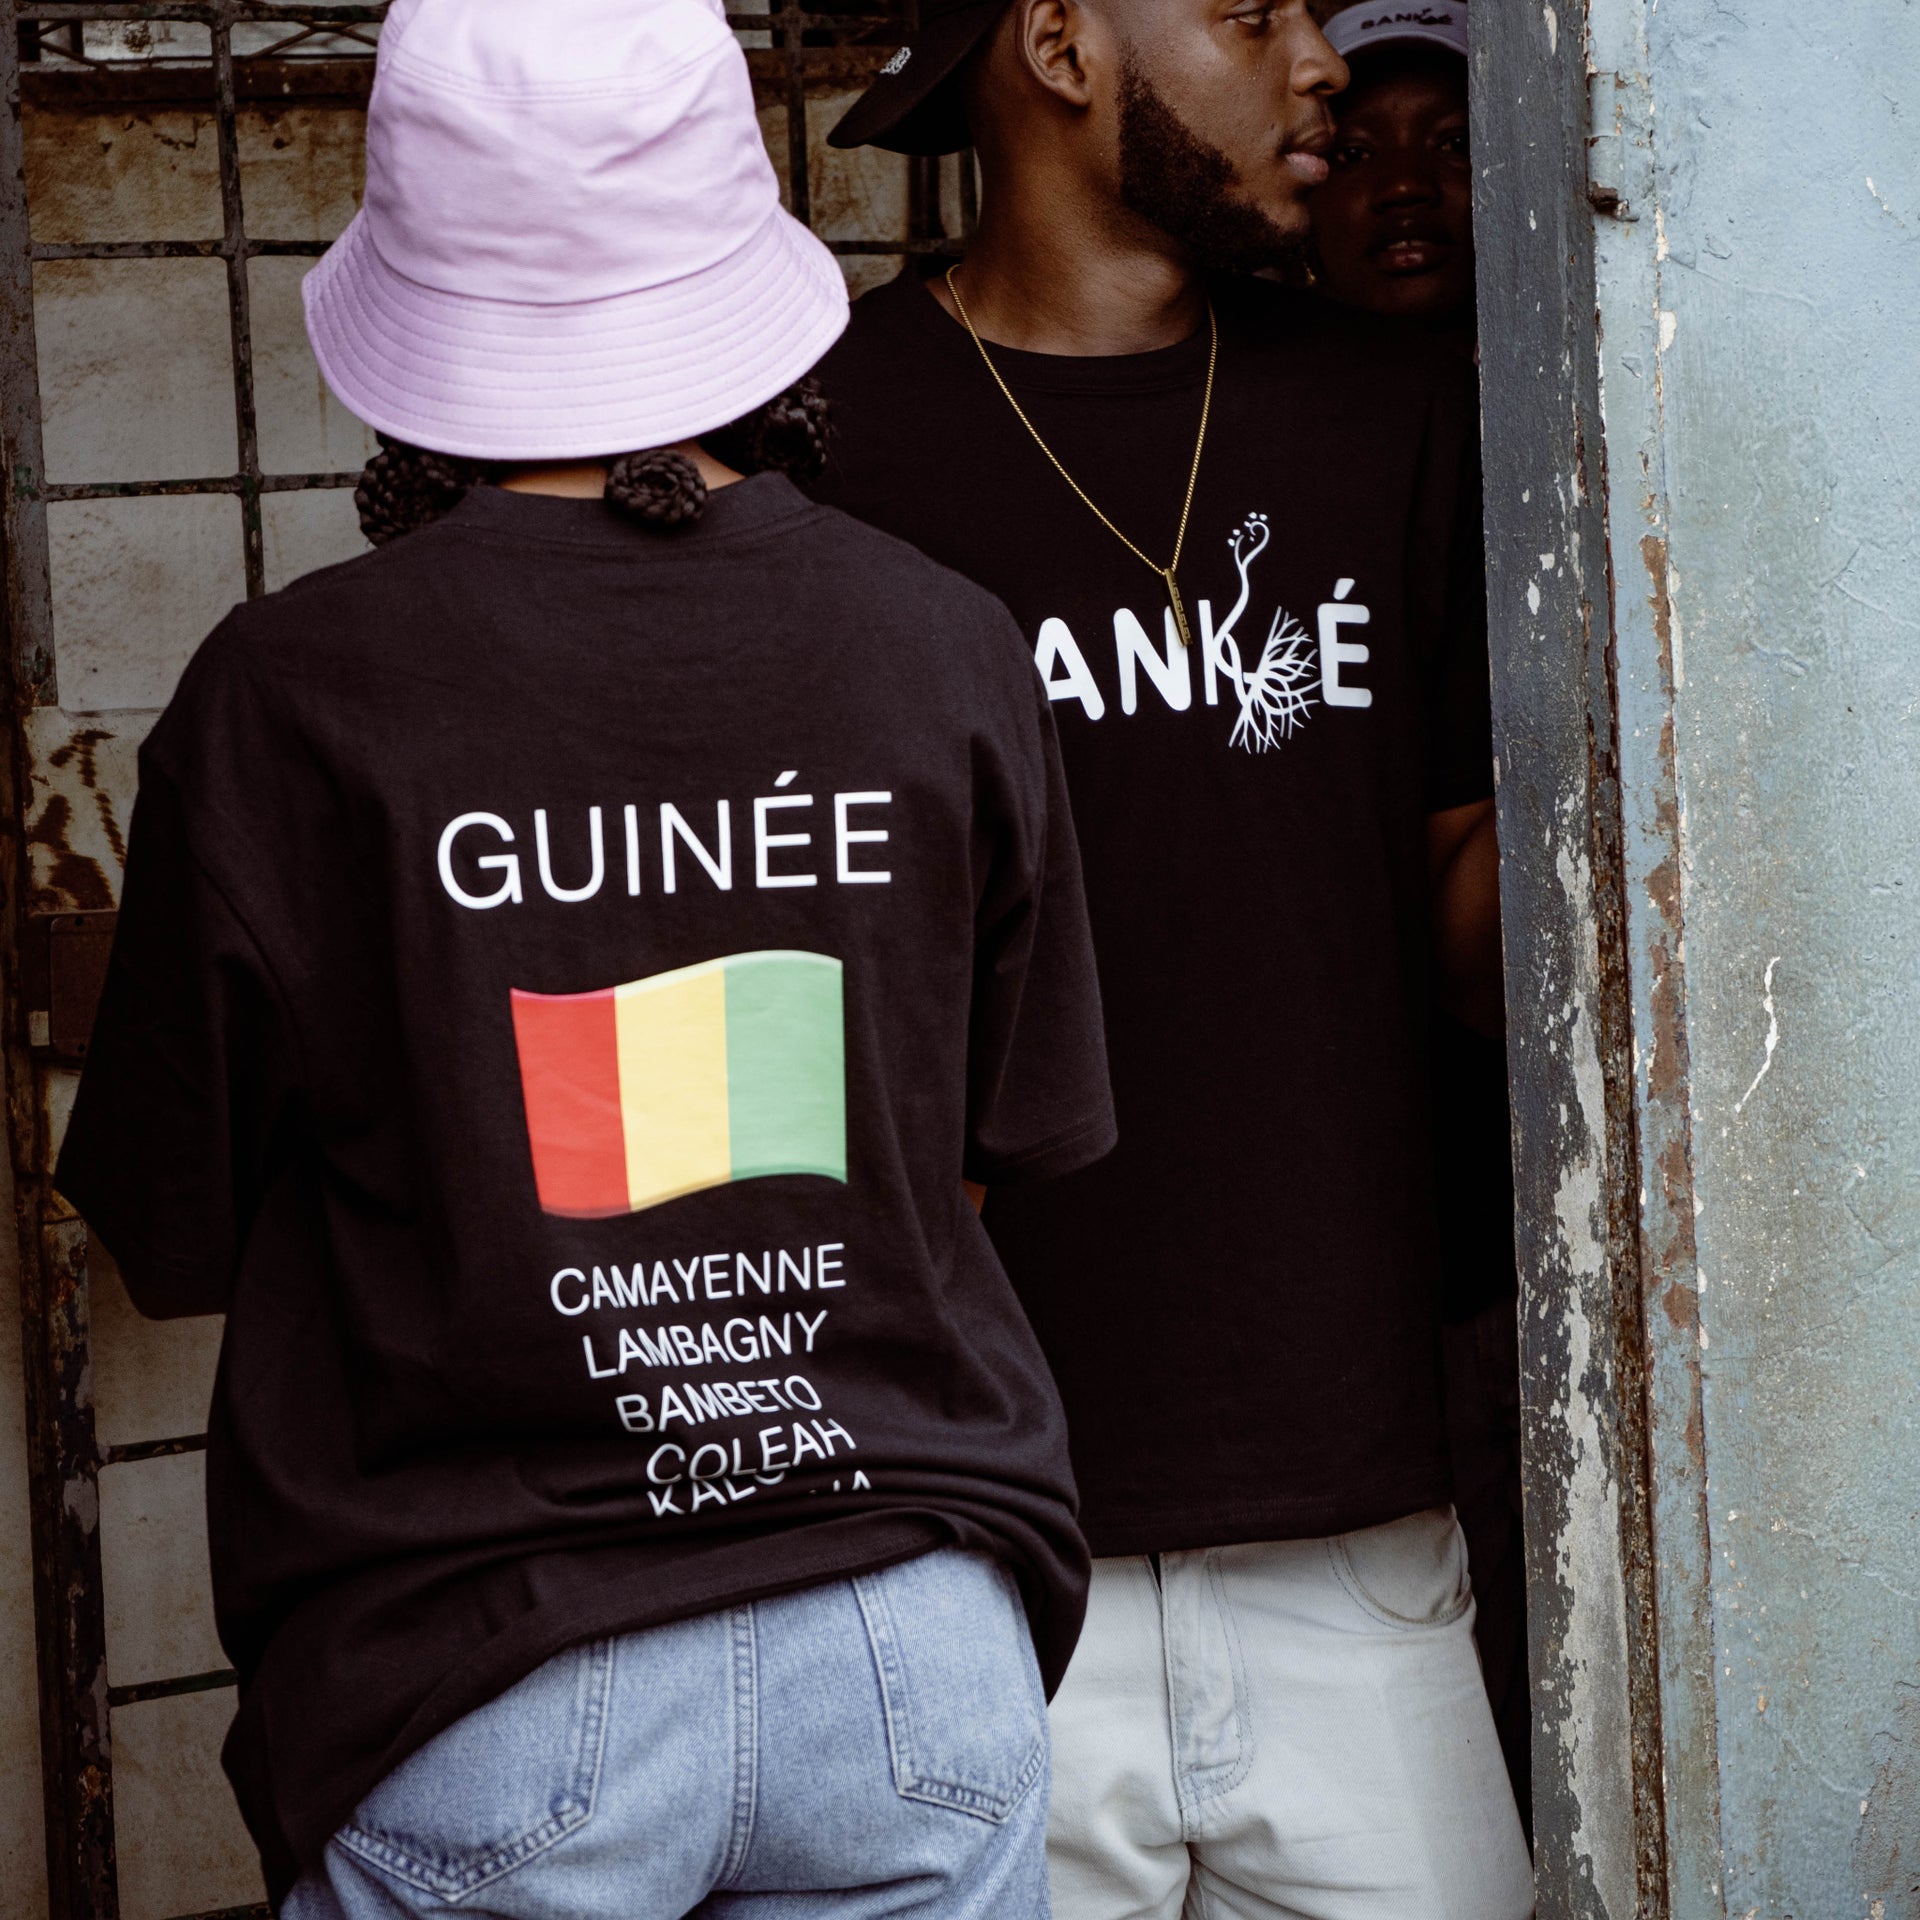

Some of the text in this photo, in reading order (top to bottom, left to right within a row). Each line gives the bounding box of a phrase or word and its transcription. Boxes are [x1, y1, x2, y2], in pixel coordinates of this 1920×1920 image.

[437, 771, 893, 910] GUINÉE
[550, 1243, 847, 1316] CAMAYENNE
[583, 1310, 828, 1379] LAMBAGNY
[615, 1375, 823, 1432] BAMBETO
[646, 1418, 857, 1485] COLEAH
